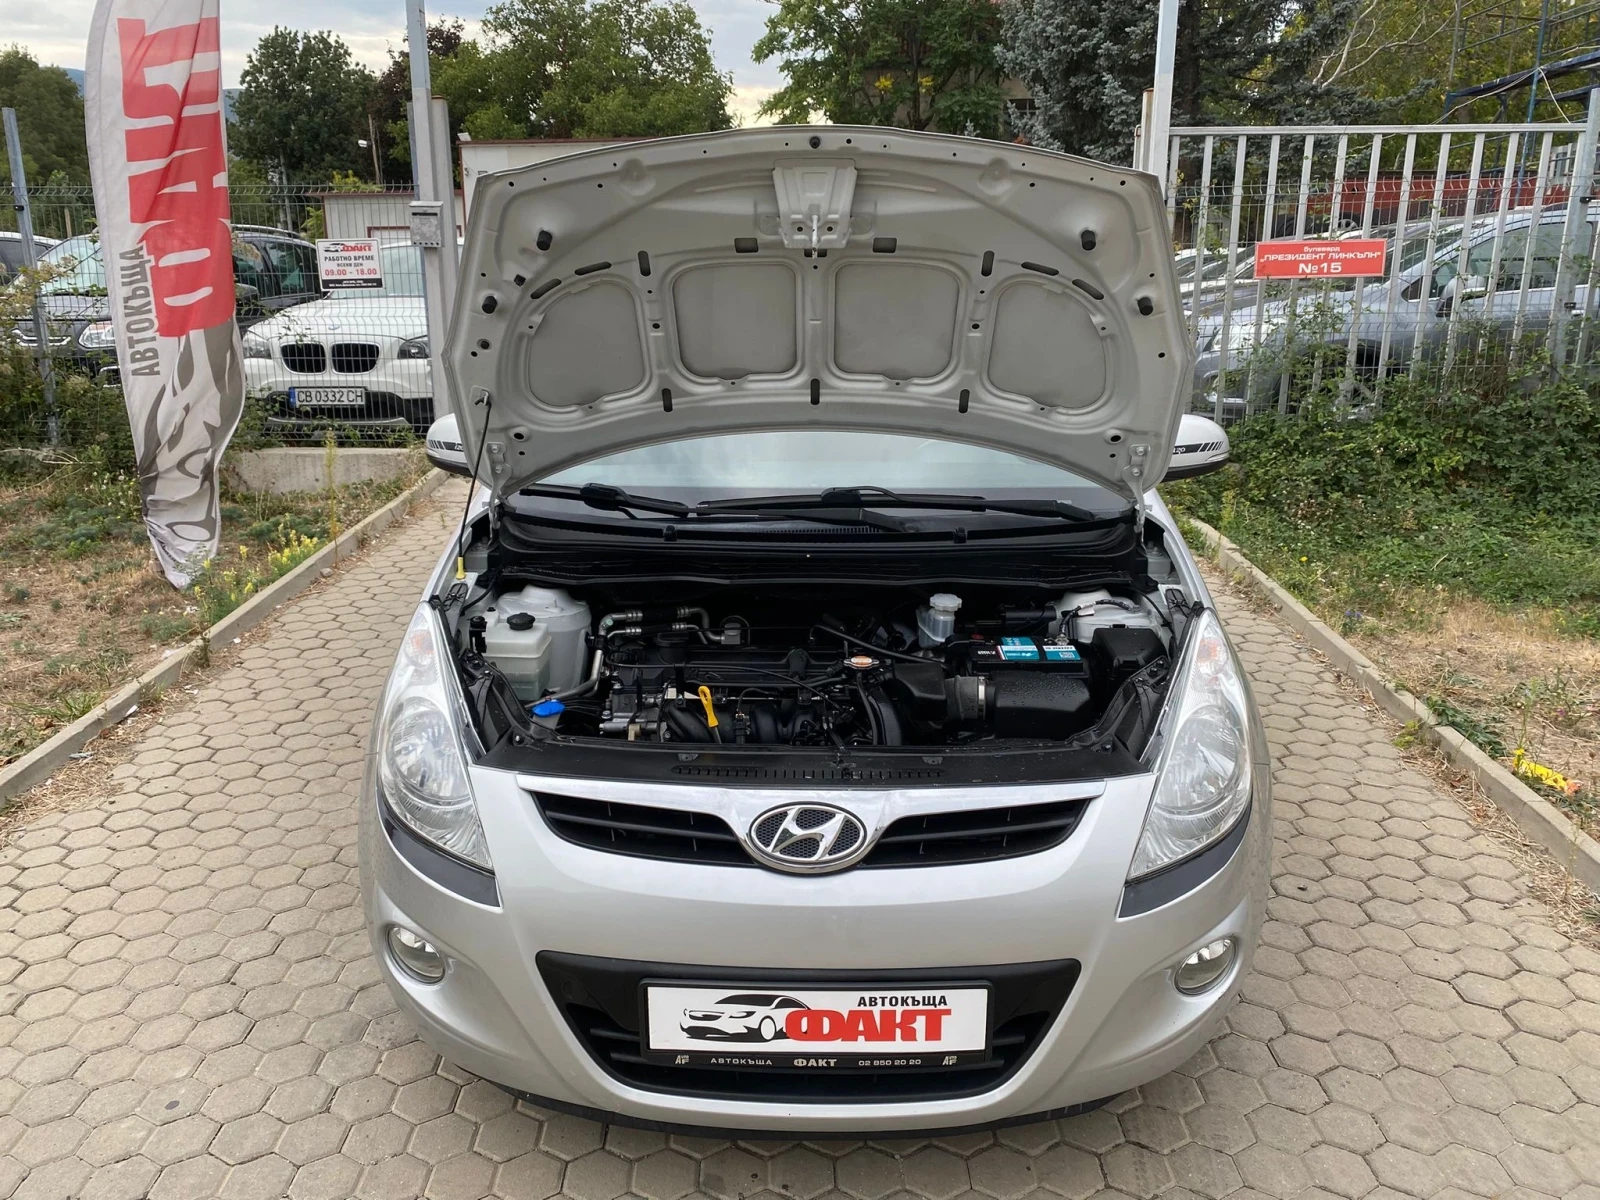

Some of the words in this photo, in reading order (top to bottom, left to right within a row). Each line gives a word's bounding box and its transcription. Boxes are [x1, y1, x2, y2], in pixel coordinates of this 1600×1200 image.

[119, 244, 160, 377] АВТОКЪЩА
[315, 390, 344, 403] 0332
[857, 995, 948, 1008] АВТОКЪЩА
[785, 1008, 952, 1042] ФАКТ
[793, 1058, 837, 1067] ФАКТ
